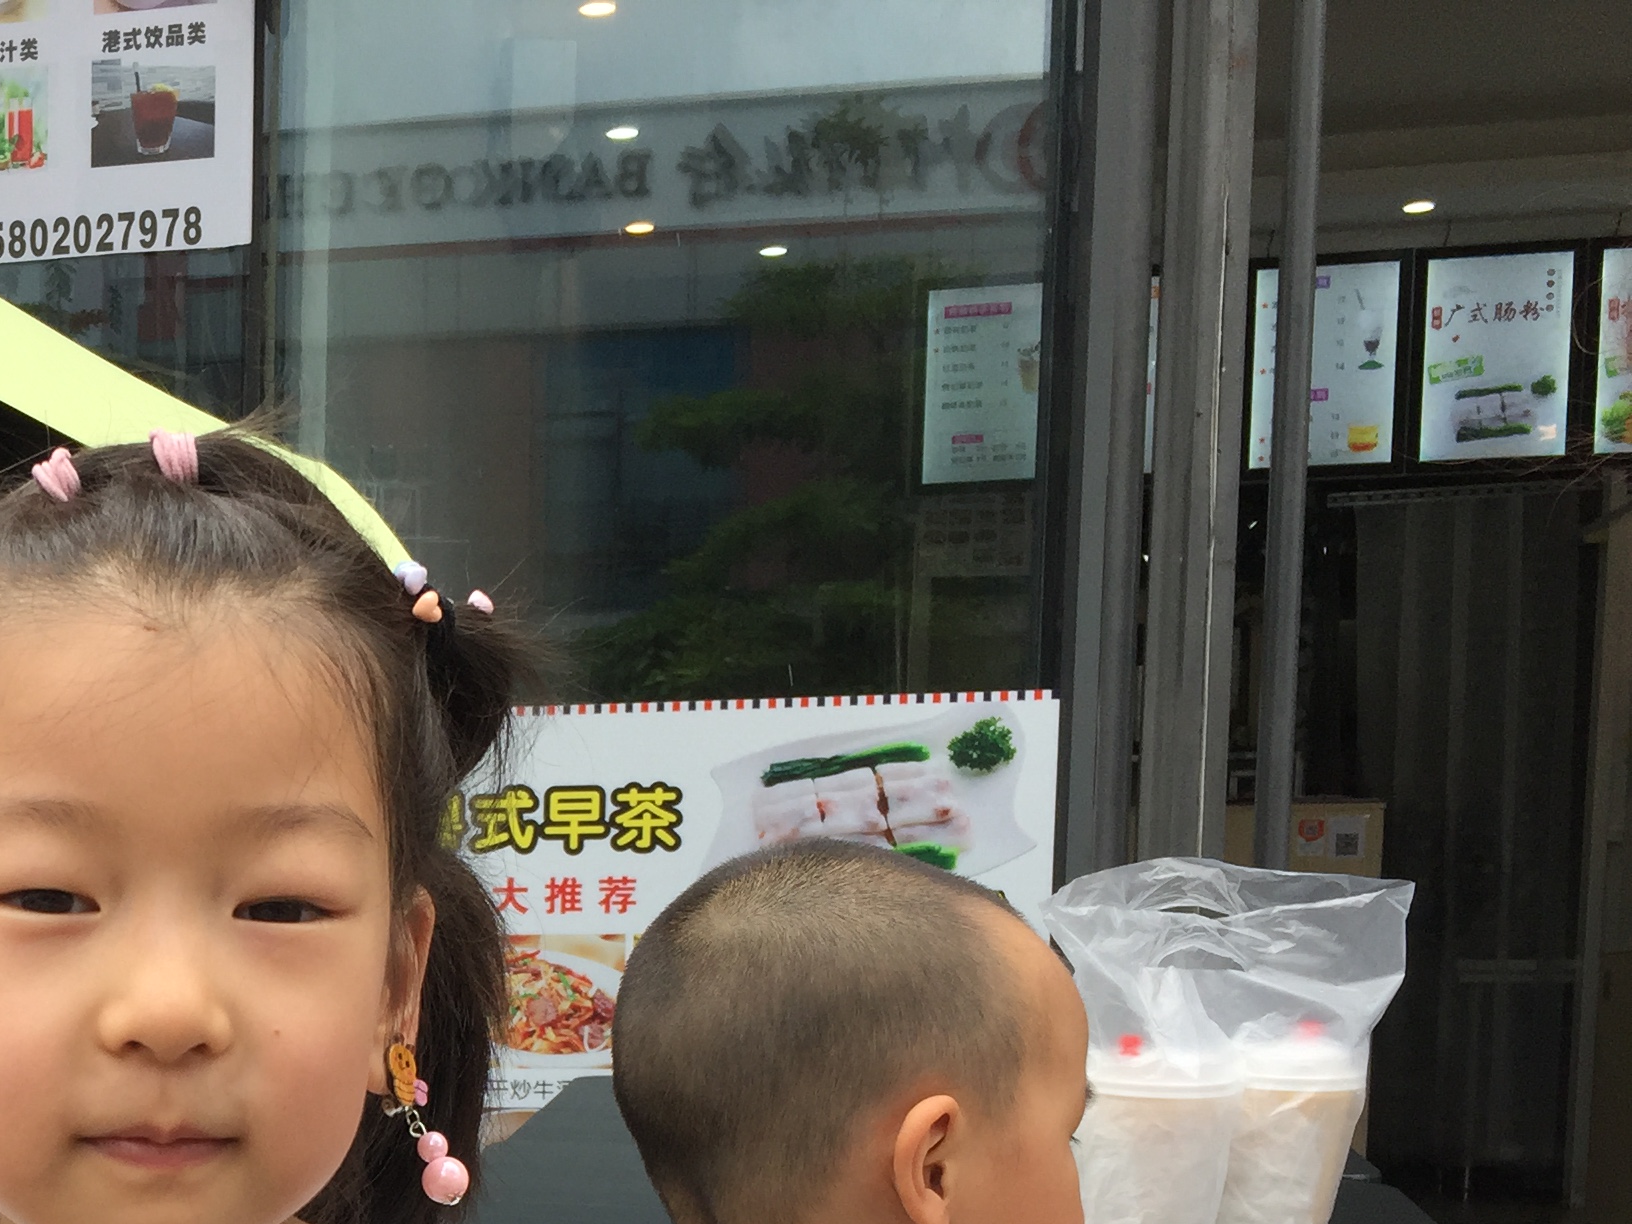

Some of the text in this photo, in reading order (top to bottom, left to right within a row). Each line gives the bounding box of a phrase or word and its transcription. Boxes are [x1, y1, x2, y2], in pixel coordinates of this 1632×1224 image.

[101, 22, 207, 53] 港式饮品类
[1444, 299, 1545, 328] 广式肠粉
